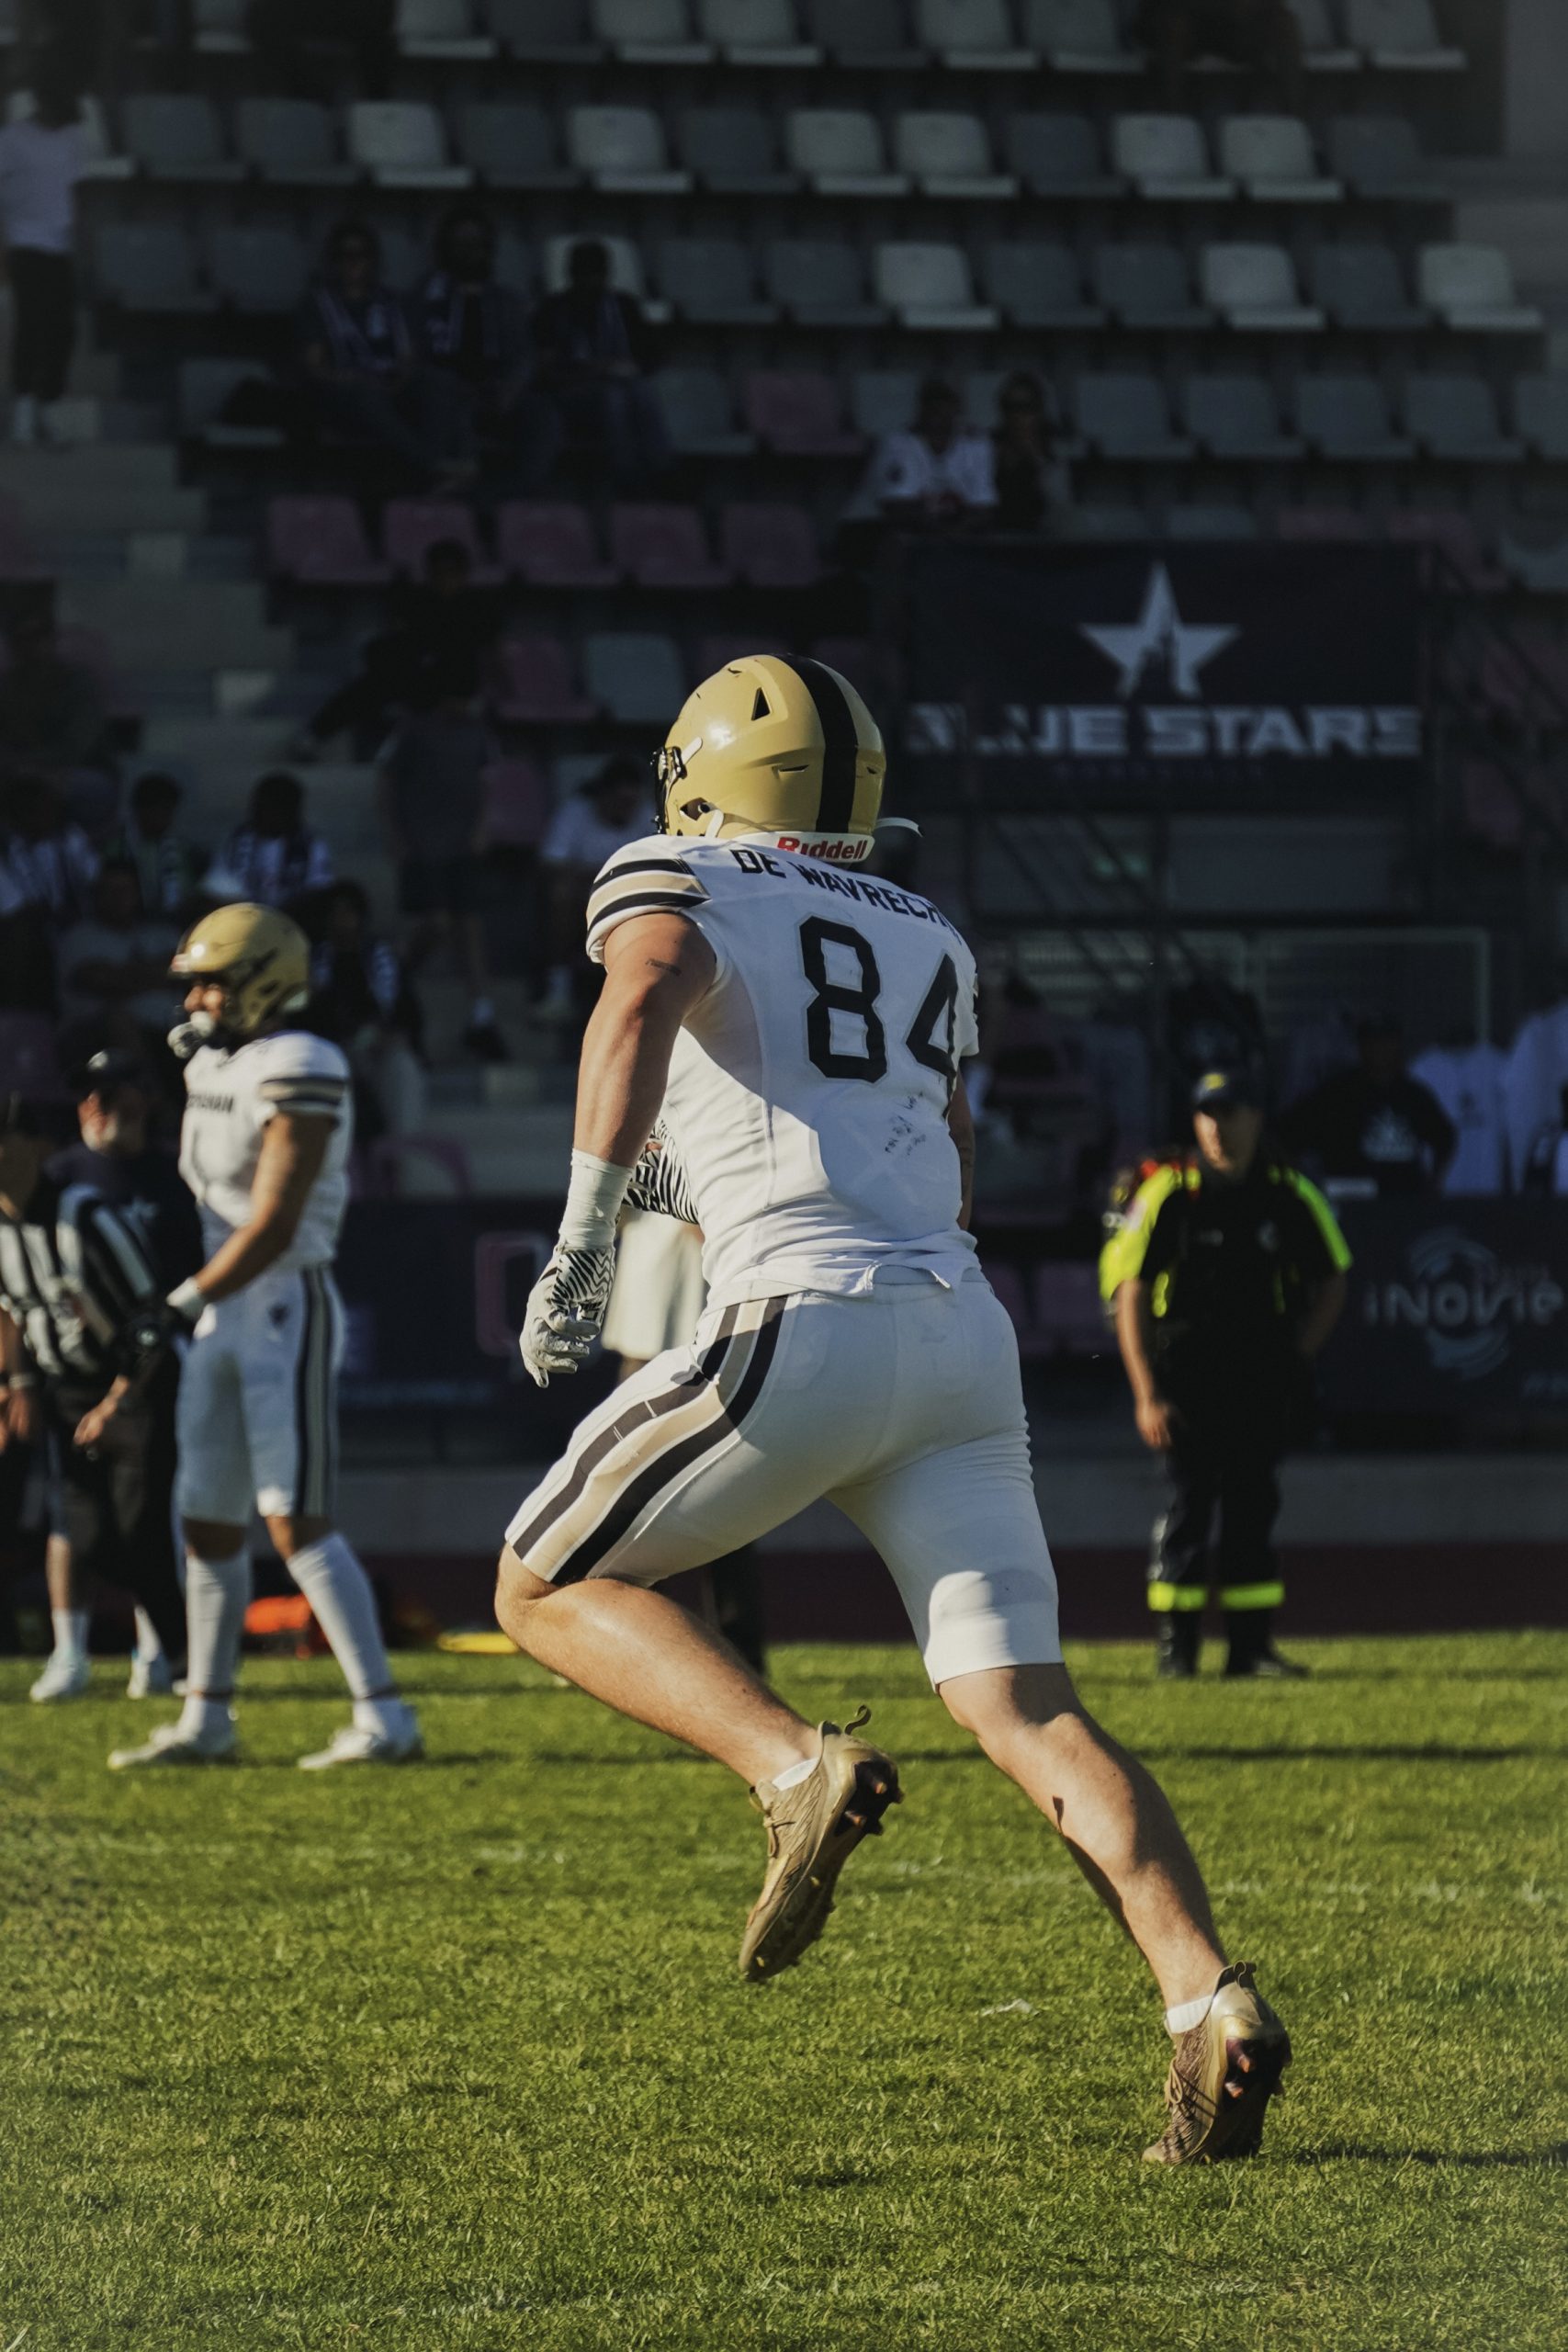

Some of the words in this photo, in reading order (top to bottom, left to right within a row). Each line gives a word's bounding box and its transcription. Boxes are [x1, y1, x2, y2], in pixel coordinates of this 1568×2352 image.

[1145, 705, 1424, 756] STARS
[729, 849, 787, 878] DE
[776, 836, 868, 860] Riddell
[799, 915, 958, 1101] 84
